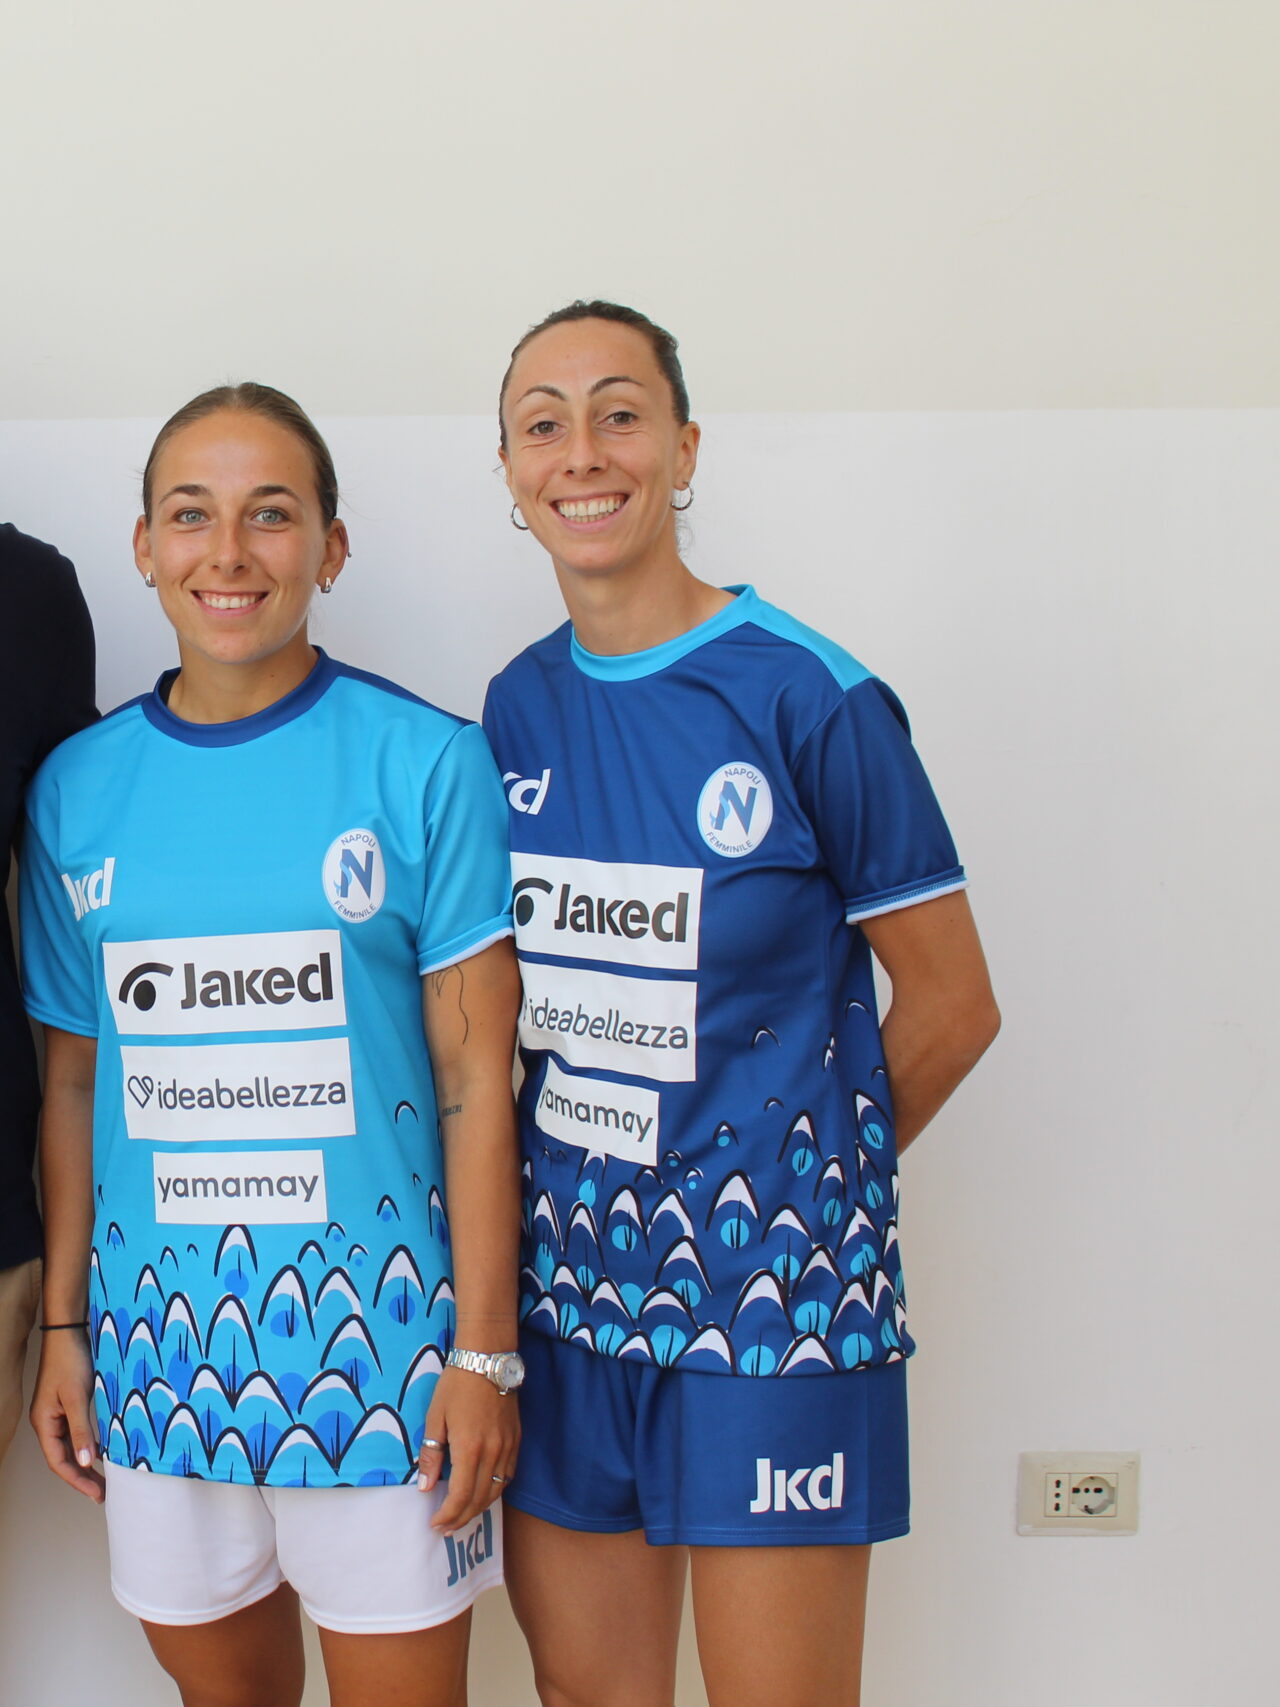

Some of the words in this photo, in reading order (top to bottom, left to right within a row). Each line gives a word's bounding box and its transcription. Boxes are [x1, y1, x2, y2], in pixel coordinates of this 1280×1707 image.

[724, 767, 761, 785] NAPOLI
[714, 780, 757, 836] N
[341, 833, 376, 848] NAPOLI
[706, 831, 753, 853] FEMMINILE
[340, 848, 374, 900] N
[334, 900, 376, 919] FEMMINILE
[554, 883, 689, 942] Jaked
[181, 952, 333, 1009] Jaked
[529, 998, 689, 1049] ideabellezza
[157, 1077, 346, 1110] ideabellezza
[157, 1173, 319, 1203] yamamay
